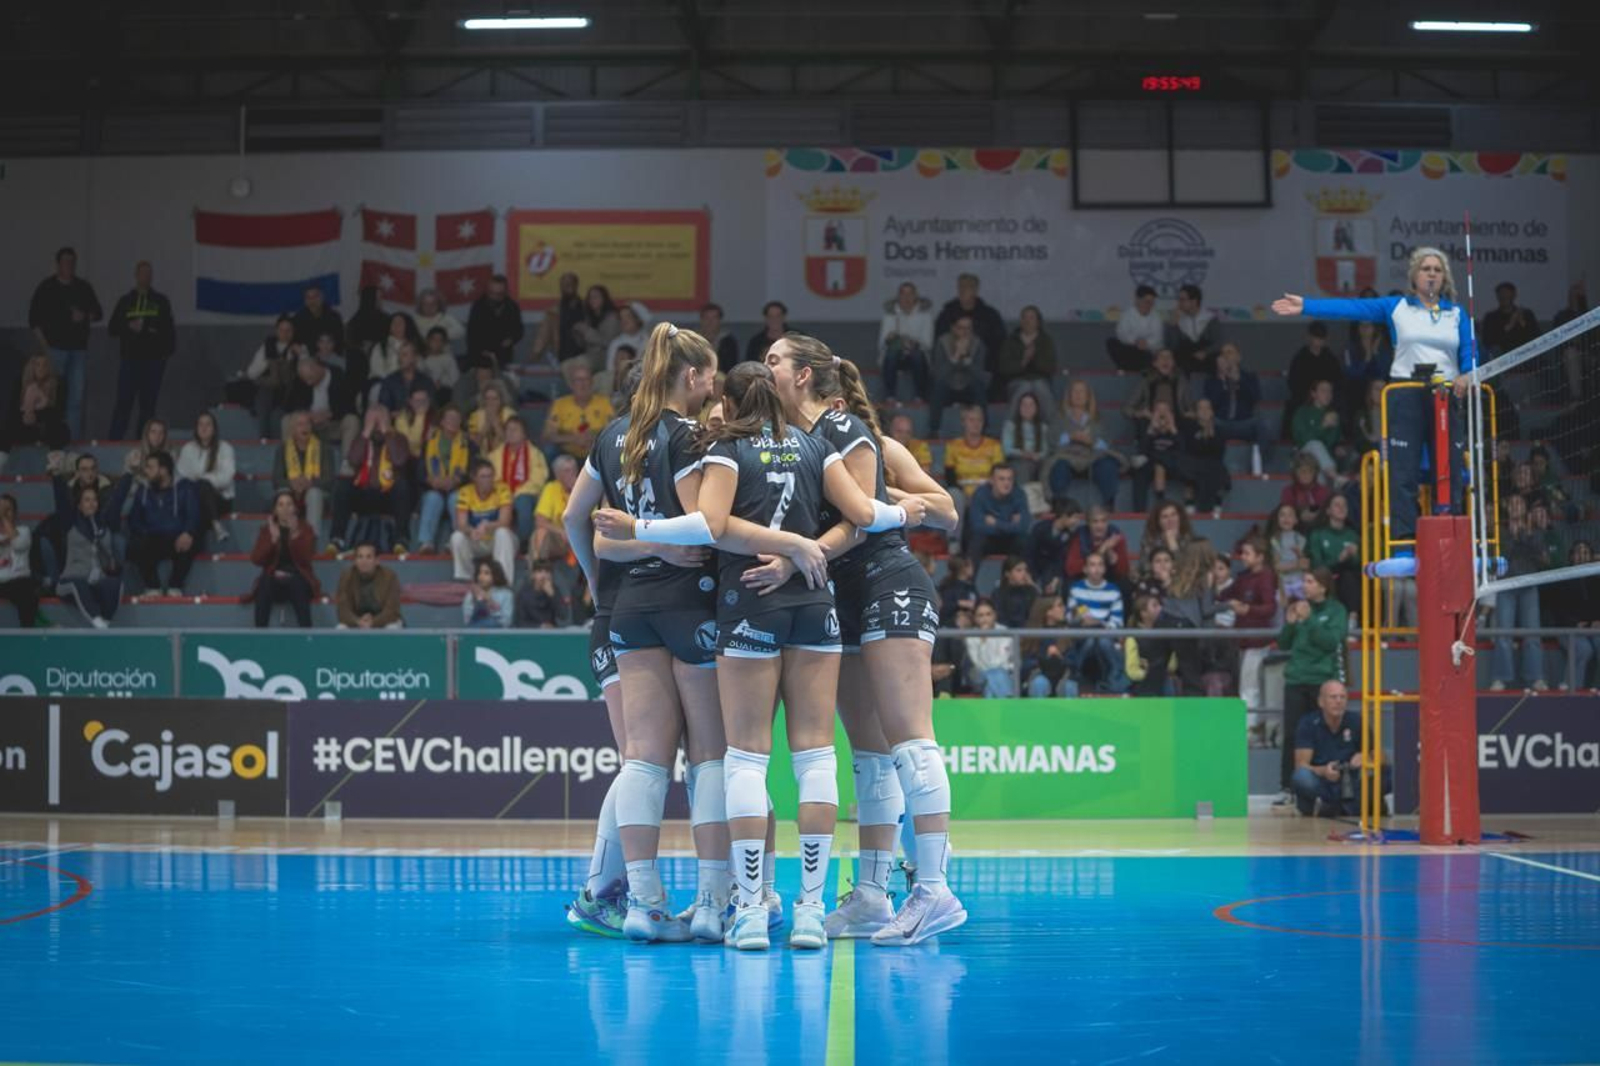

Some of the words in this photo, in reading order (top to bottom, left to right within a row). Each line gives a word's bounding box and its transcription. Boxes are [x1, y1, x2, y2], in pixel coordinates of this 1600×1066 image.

[884, 216, 1018, 238] Ayuntamiento
[1023, 216, 1048, 233] de
[1523, 217, 1549, 236] de
[885, 241, 927, 260] Dos
[935, 241, 1048, 260] Hermanas
[1440, 243, 1549, 262] Hermanas
[765, 471, 796, 530] 7
[891, 610, 911, 626] 12
[46, 667, 156, 690] Diputación
[316, 667, 430, 691] Diputación
[89, 726, 279, 791] Cajasol
[941, 745, 1117, 773] HERMANAS
[1477, 732, 1600, 769] EVCha
